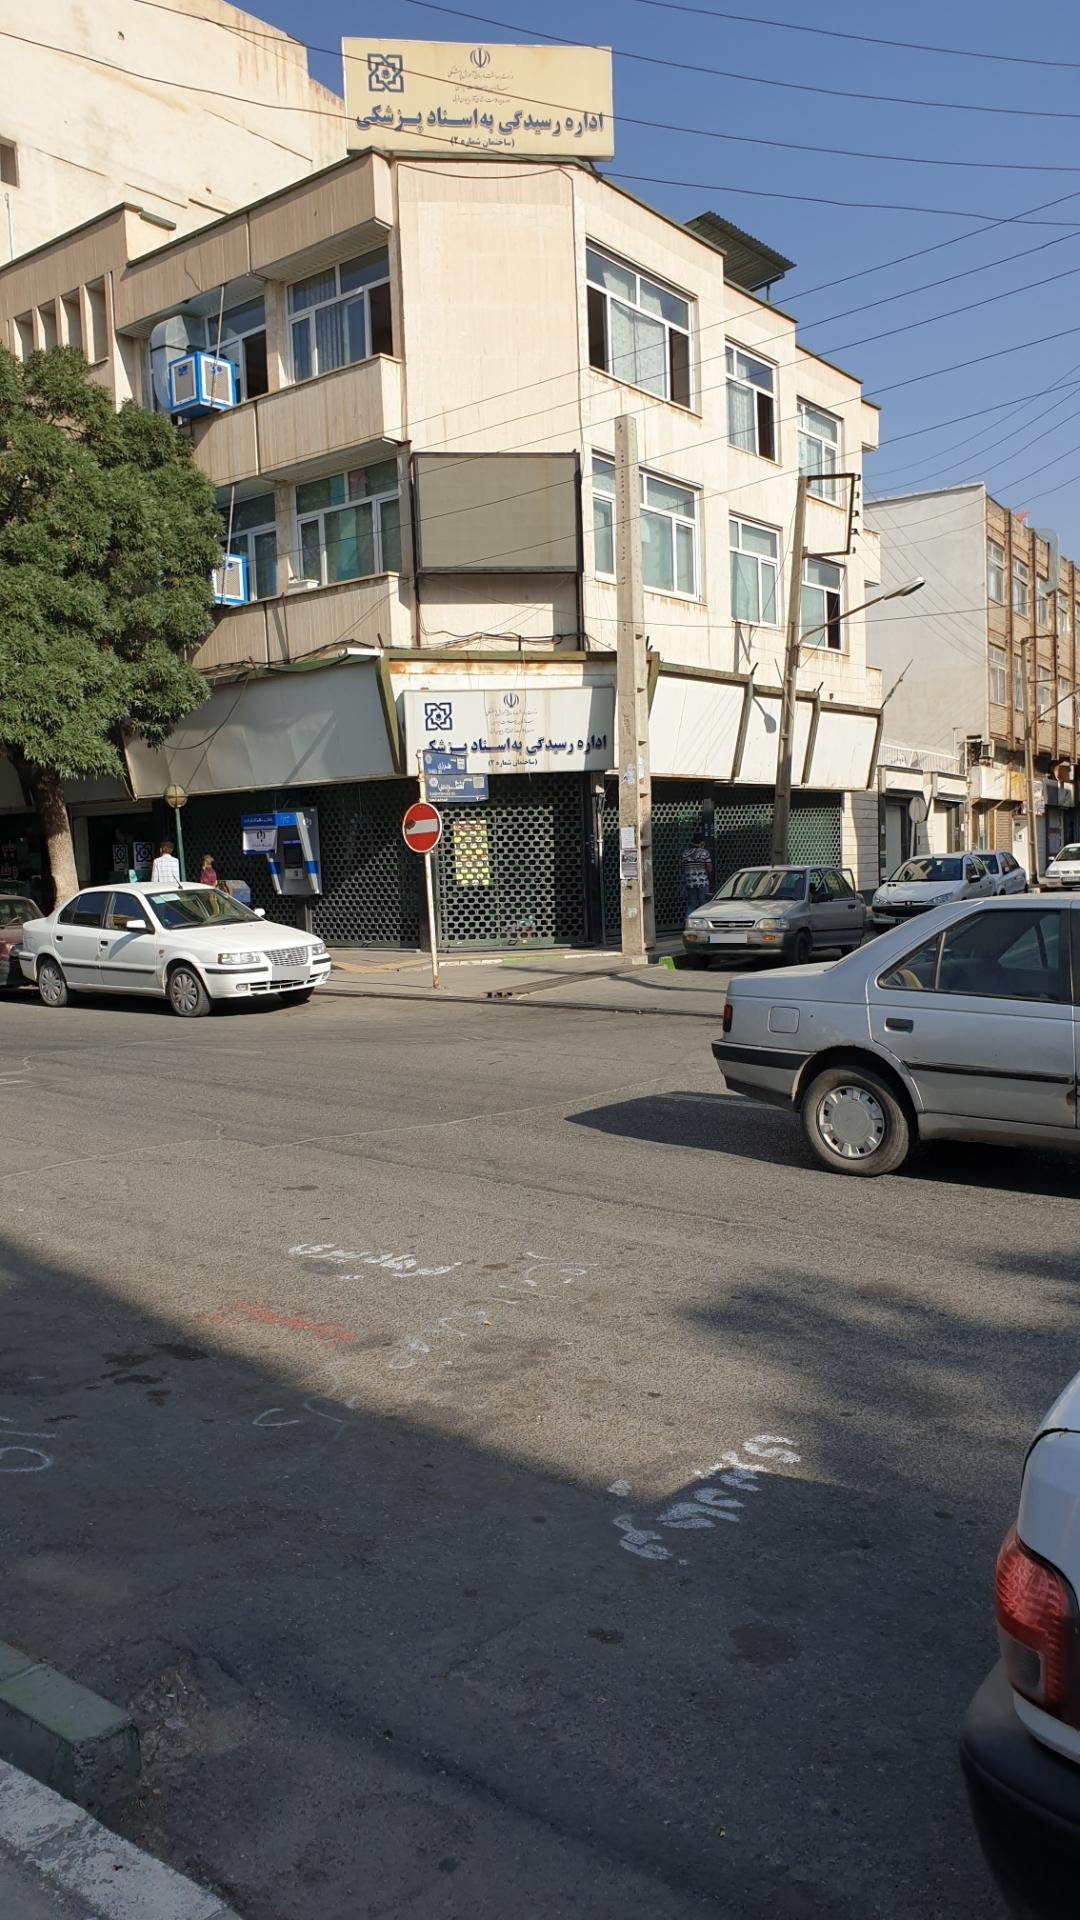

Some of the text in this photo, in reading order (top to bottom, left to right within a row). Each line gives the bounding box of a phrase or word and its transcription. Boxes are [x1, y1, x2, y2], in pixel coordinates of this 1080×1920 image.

[356, 104, 603, 137] اداره رسیدگی به اسناد پزشکی
[460, 137, 481, 147] شماره
[482, 138, 515, 148] (ساختمان
[428, 735, 607, 755] اداره رسیدگی به اسناد پزشک
